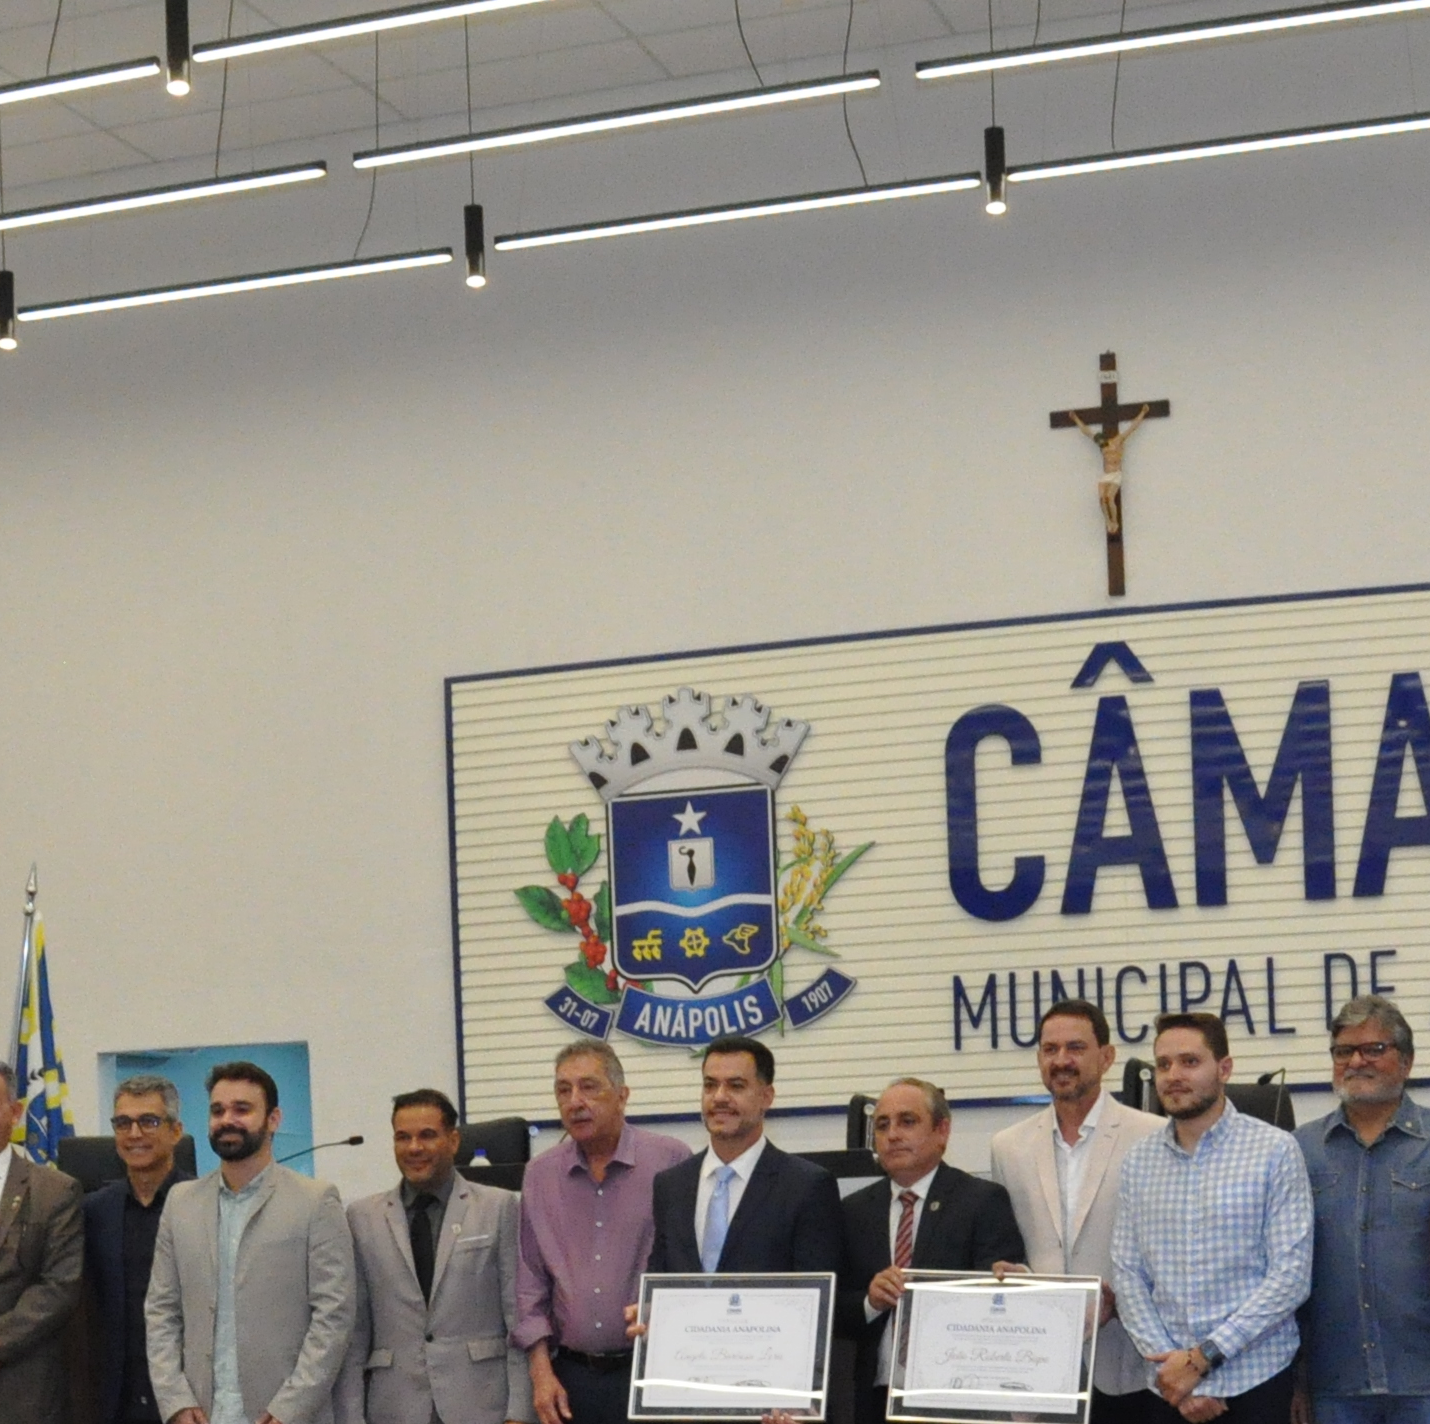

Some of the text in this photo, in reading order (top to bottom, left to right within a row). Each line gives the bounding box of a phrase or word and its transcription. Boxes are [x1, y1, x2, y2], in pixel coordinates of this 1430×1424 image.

[801, 980, 835, 1013] 1907
[1323, 949, 1397, 1031] DE
[558, 997, 600, 1030] 31-07
[633, 995, 764, 1038] ANÁPOLIS
[684, 1325, 731, 1333] CIDADANIA
[946, 1323, 994, 1333] CIDADANIA
